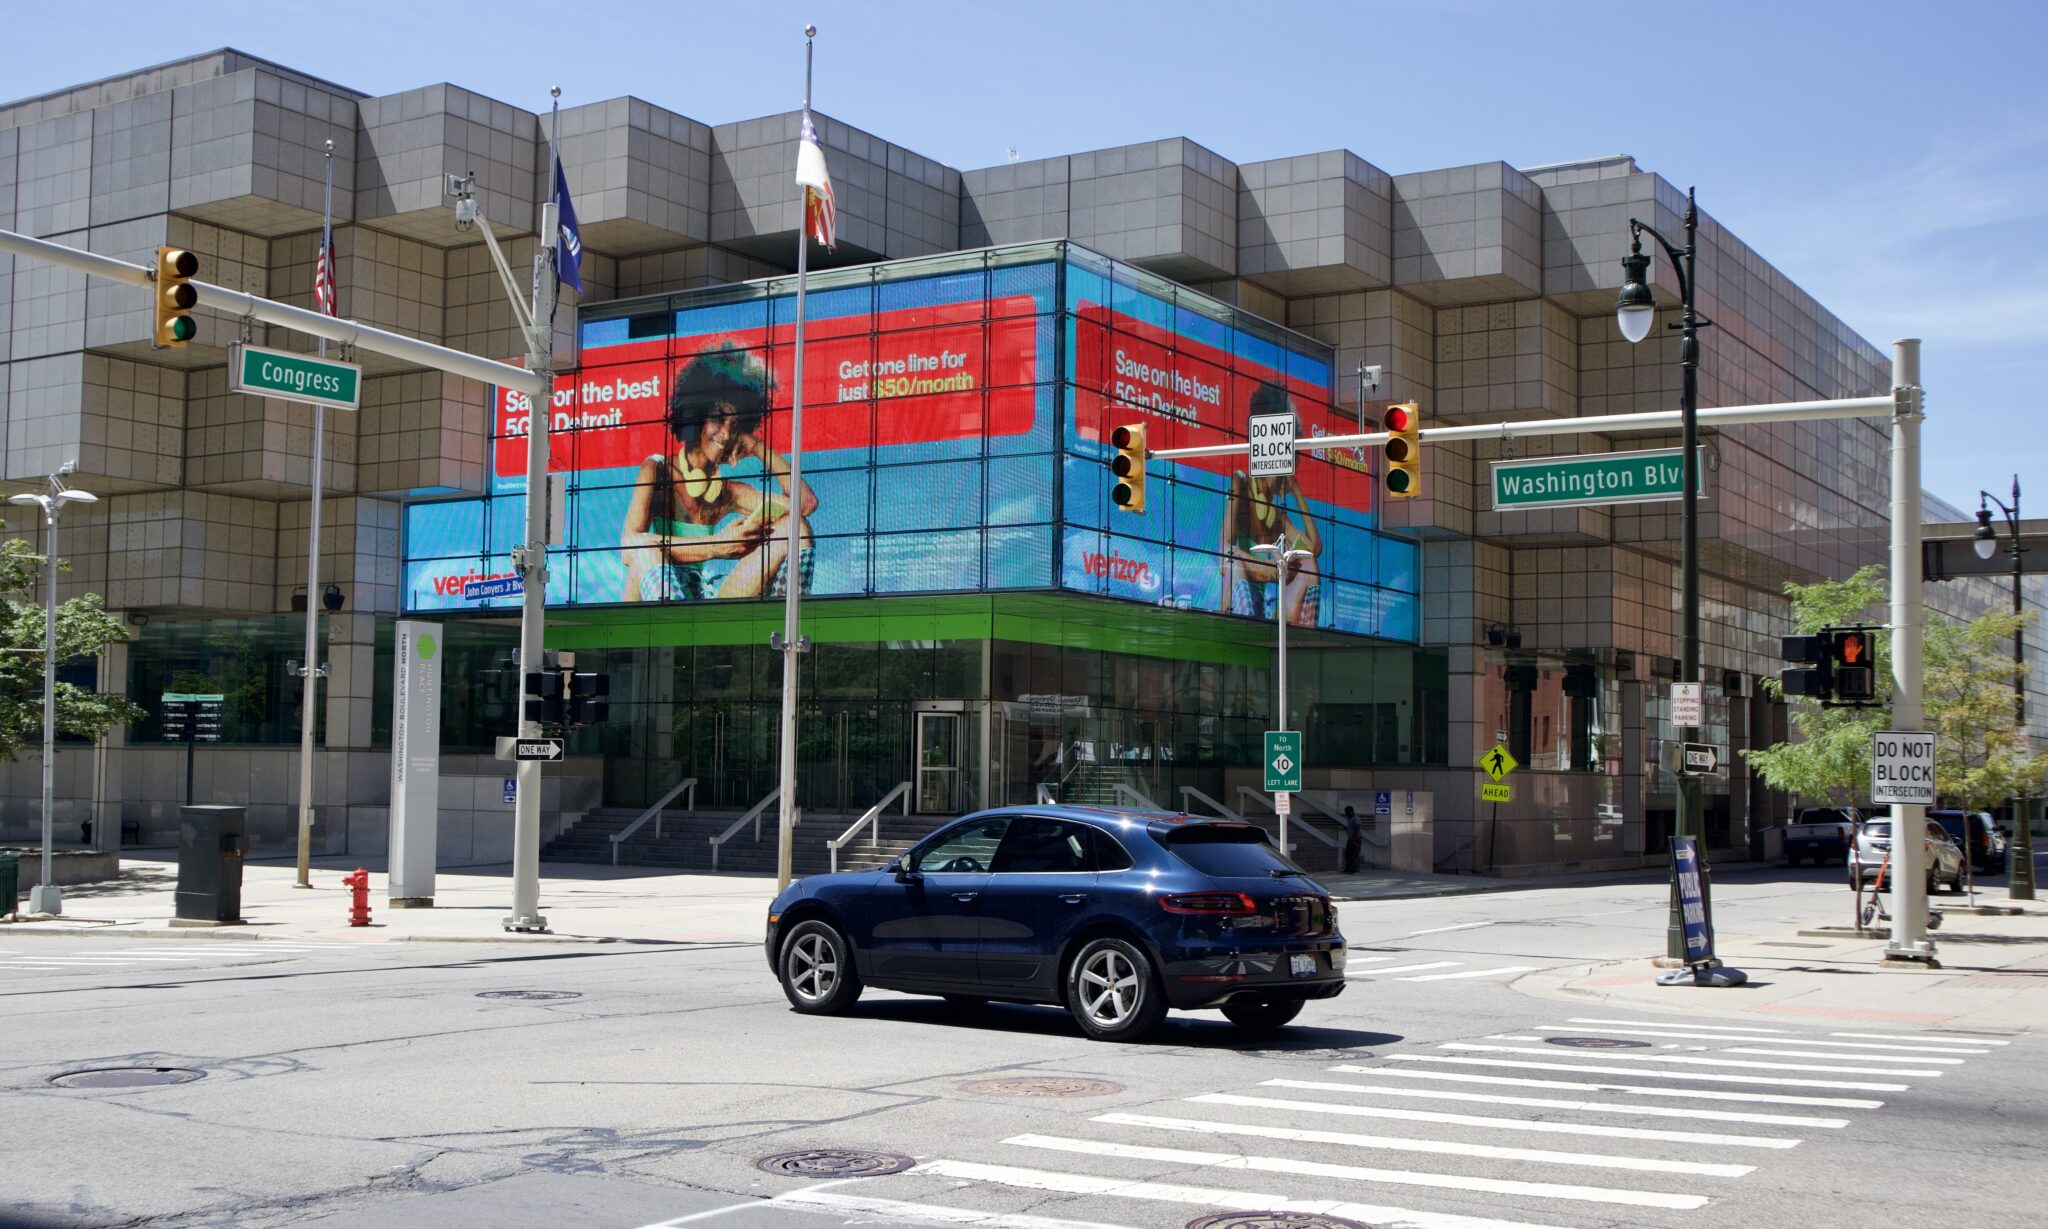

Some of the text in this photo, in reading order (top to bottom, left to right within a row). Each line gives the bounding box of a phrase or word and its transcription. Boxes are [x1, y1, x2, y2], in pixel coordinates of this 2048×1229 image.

[261, 361, 340, 392] Congress
[838, 350, 967, 380] Get one line for
[1115, 349, 1220, 406] Save on the best
[553, 388, 578, 408] on
[582, 380, 614, 404] the
[616, 375, 660, 401] best
[838, 371, 974, 403] just $50/month
[1115, 381, 1136, 410] 5G
[1137, 388, 1150, 414] in
[1252, 422, 1293, 438] DO NOT
[1252, 441, 1292, 458] BLOCK
[1251, 459, 1292, 471] INTERSECTION
[1502, 463, 1685, 496] Washington Blv
[1082, 549, 1150, 583] verizon
[466, 587, 480, 598] John
[480, 583, 504, 596] Conyers
[505, 581, 512, 592] Jr
[418, 663, 426, 695] PLACE
[399, 667, 407, 720] BOULEVARD
[425, 664, 433, 733] HUNTINGTON
[397, 723, 405, 783] WASHINGTON
[520, 745, 551, 754] ONE WAY
[1688, 752, 1698, 763] ONE
[1877, 741, 1932, 758] DO NOT
[1276, 758, 1289, 770] 10
[1877, 764, 1932, 782] BLOCK
[1483, 788, 1509, 798] AHEAD
[1875, 785, 1932, 798] INTERSECTION
[1679, 871, 1701, 899] PUBLIC
[1683, 902, 1705, 925] PARKING
